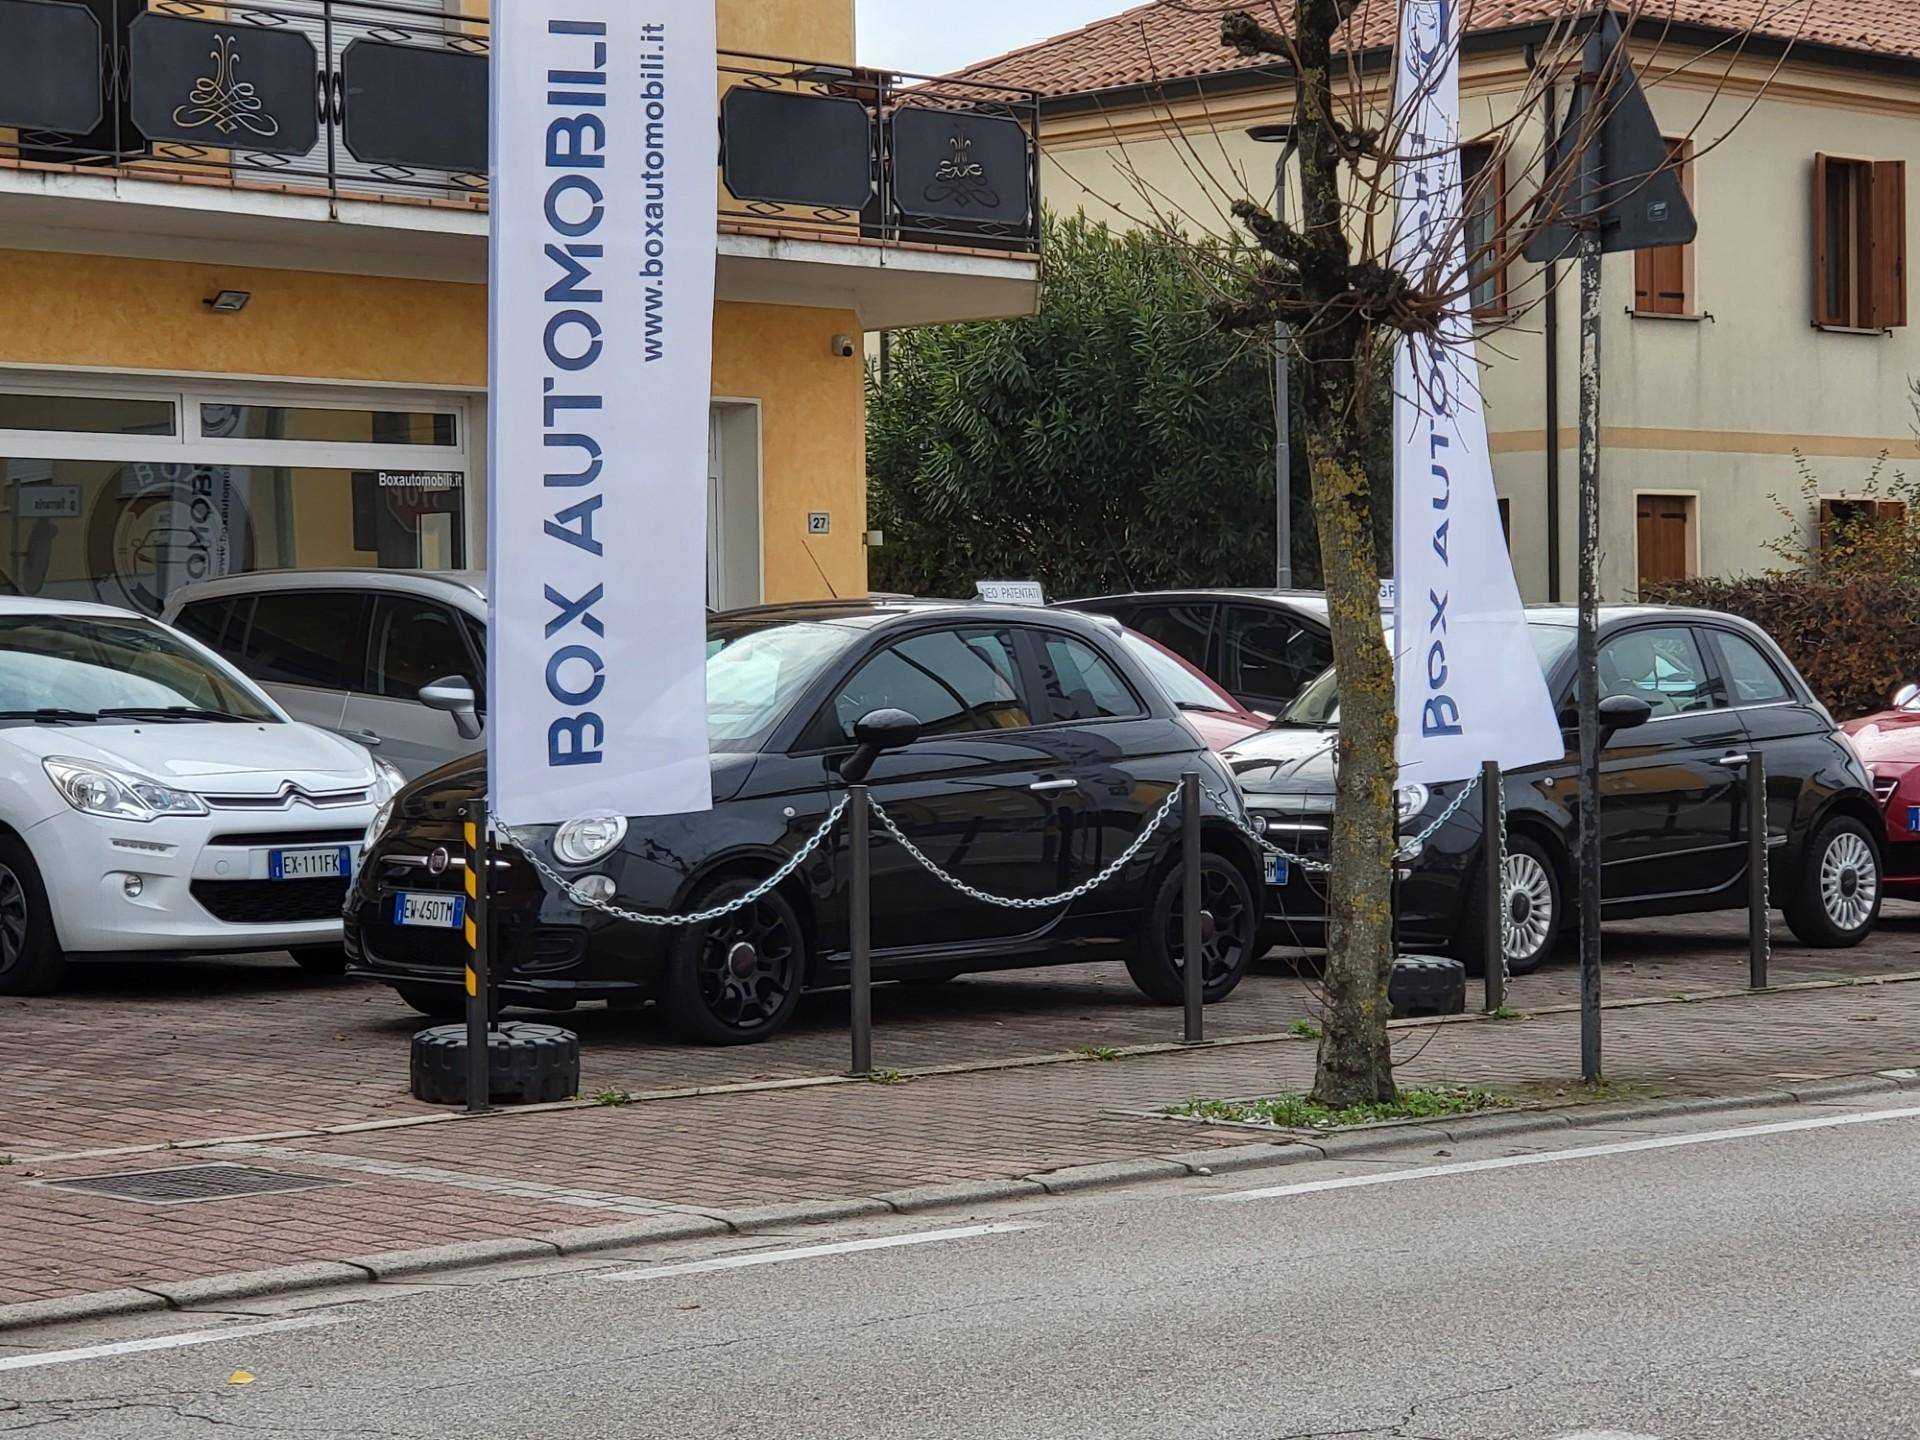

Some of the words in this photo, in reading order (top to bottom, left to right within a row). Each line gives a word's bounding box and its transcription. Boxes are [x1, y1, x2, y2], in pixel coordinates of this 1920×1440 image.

[639, 23, 665, 362] www.boxautomobili.it
[543, 19, 607, 557] AUTOMOBILI
[378, 472, 463, 487] Boxautomobili.it
[812, 517, 827, 530] 27
[545, 582, 606, 766] BOX
[1422, 588, 1464, 738] BOX
